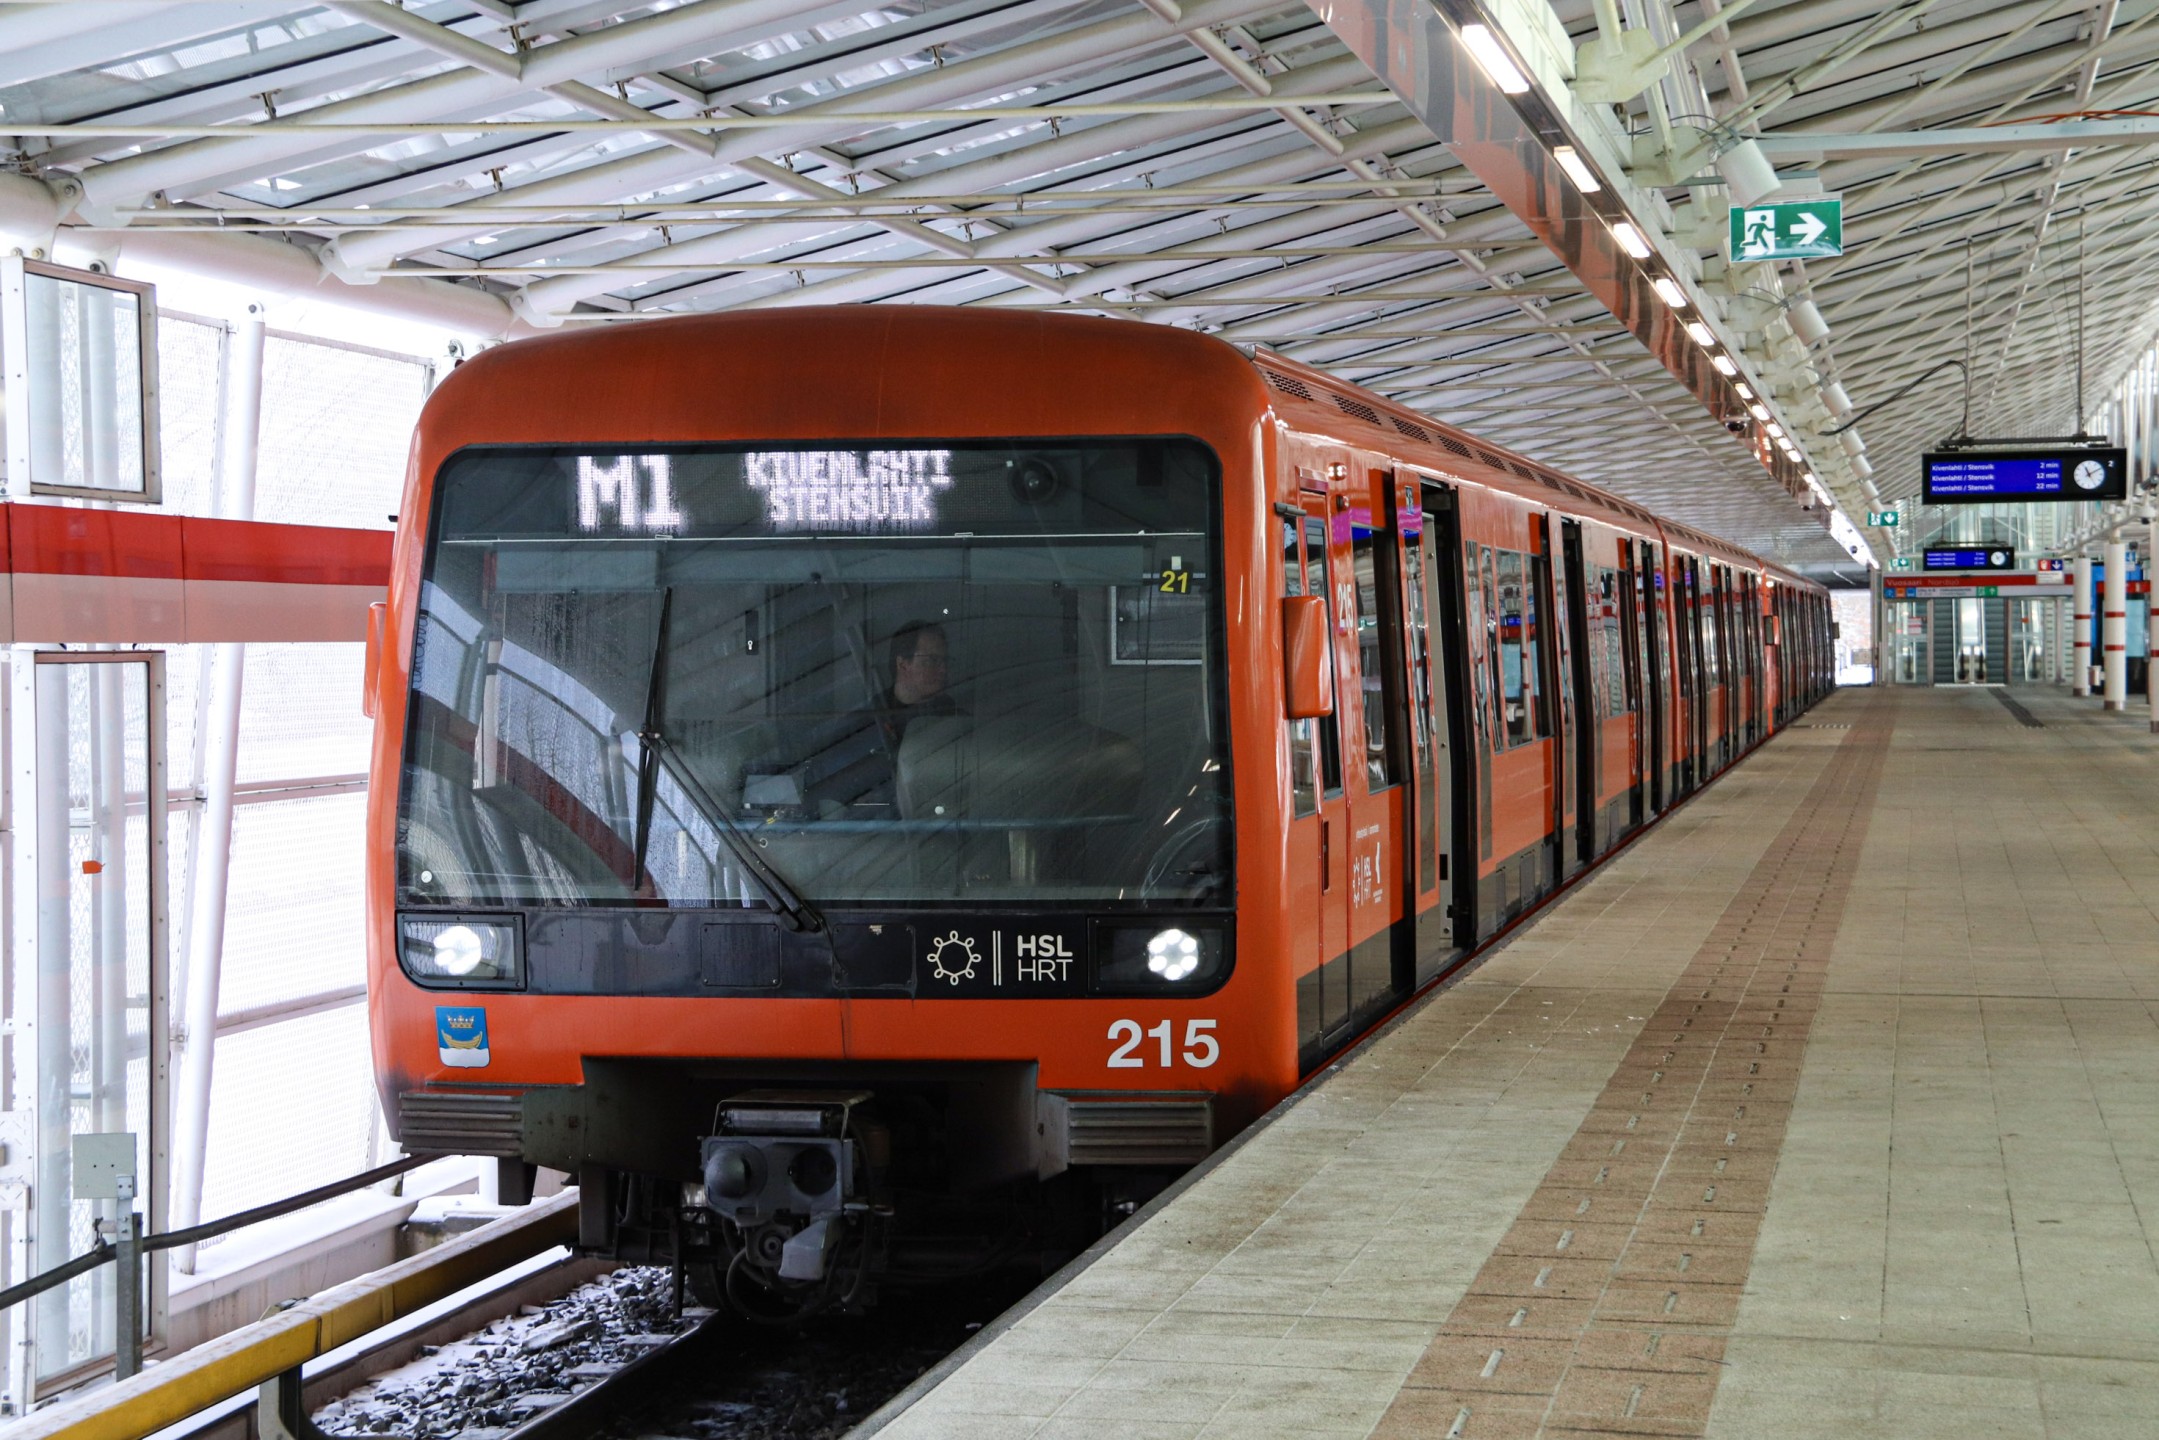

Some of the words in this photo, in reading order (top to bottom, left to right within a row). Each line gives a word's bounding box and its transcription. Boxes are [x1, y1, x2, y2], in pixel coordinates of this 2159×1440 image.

[1967, 463, 1994, 471] Stensvik
[577, 455, 680, 526] M1
[770, 486, 930, 521] STENSVIK
[1160, 570, 1188, 593] 21
[1886, 578, 1922, 586] Vuosaari
[1928, 578, 1960, 586] Nordsjö
[1337, 582, 1354, 628] 215
[1017, 935, 1073, 957] HSL
[1017, 959, 1073, 982] HRT
[1106, 1019, 1220, 1068] 215
